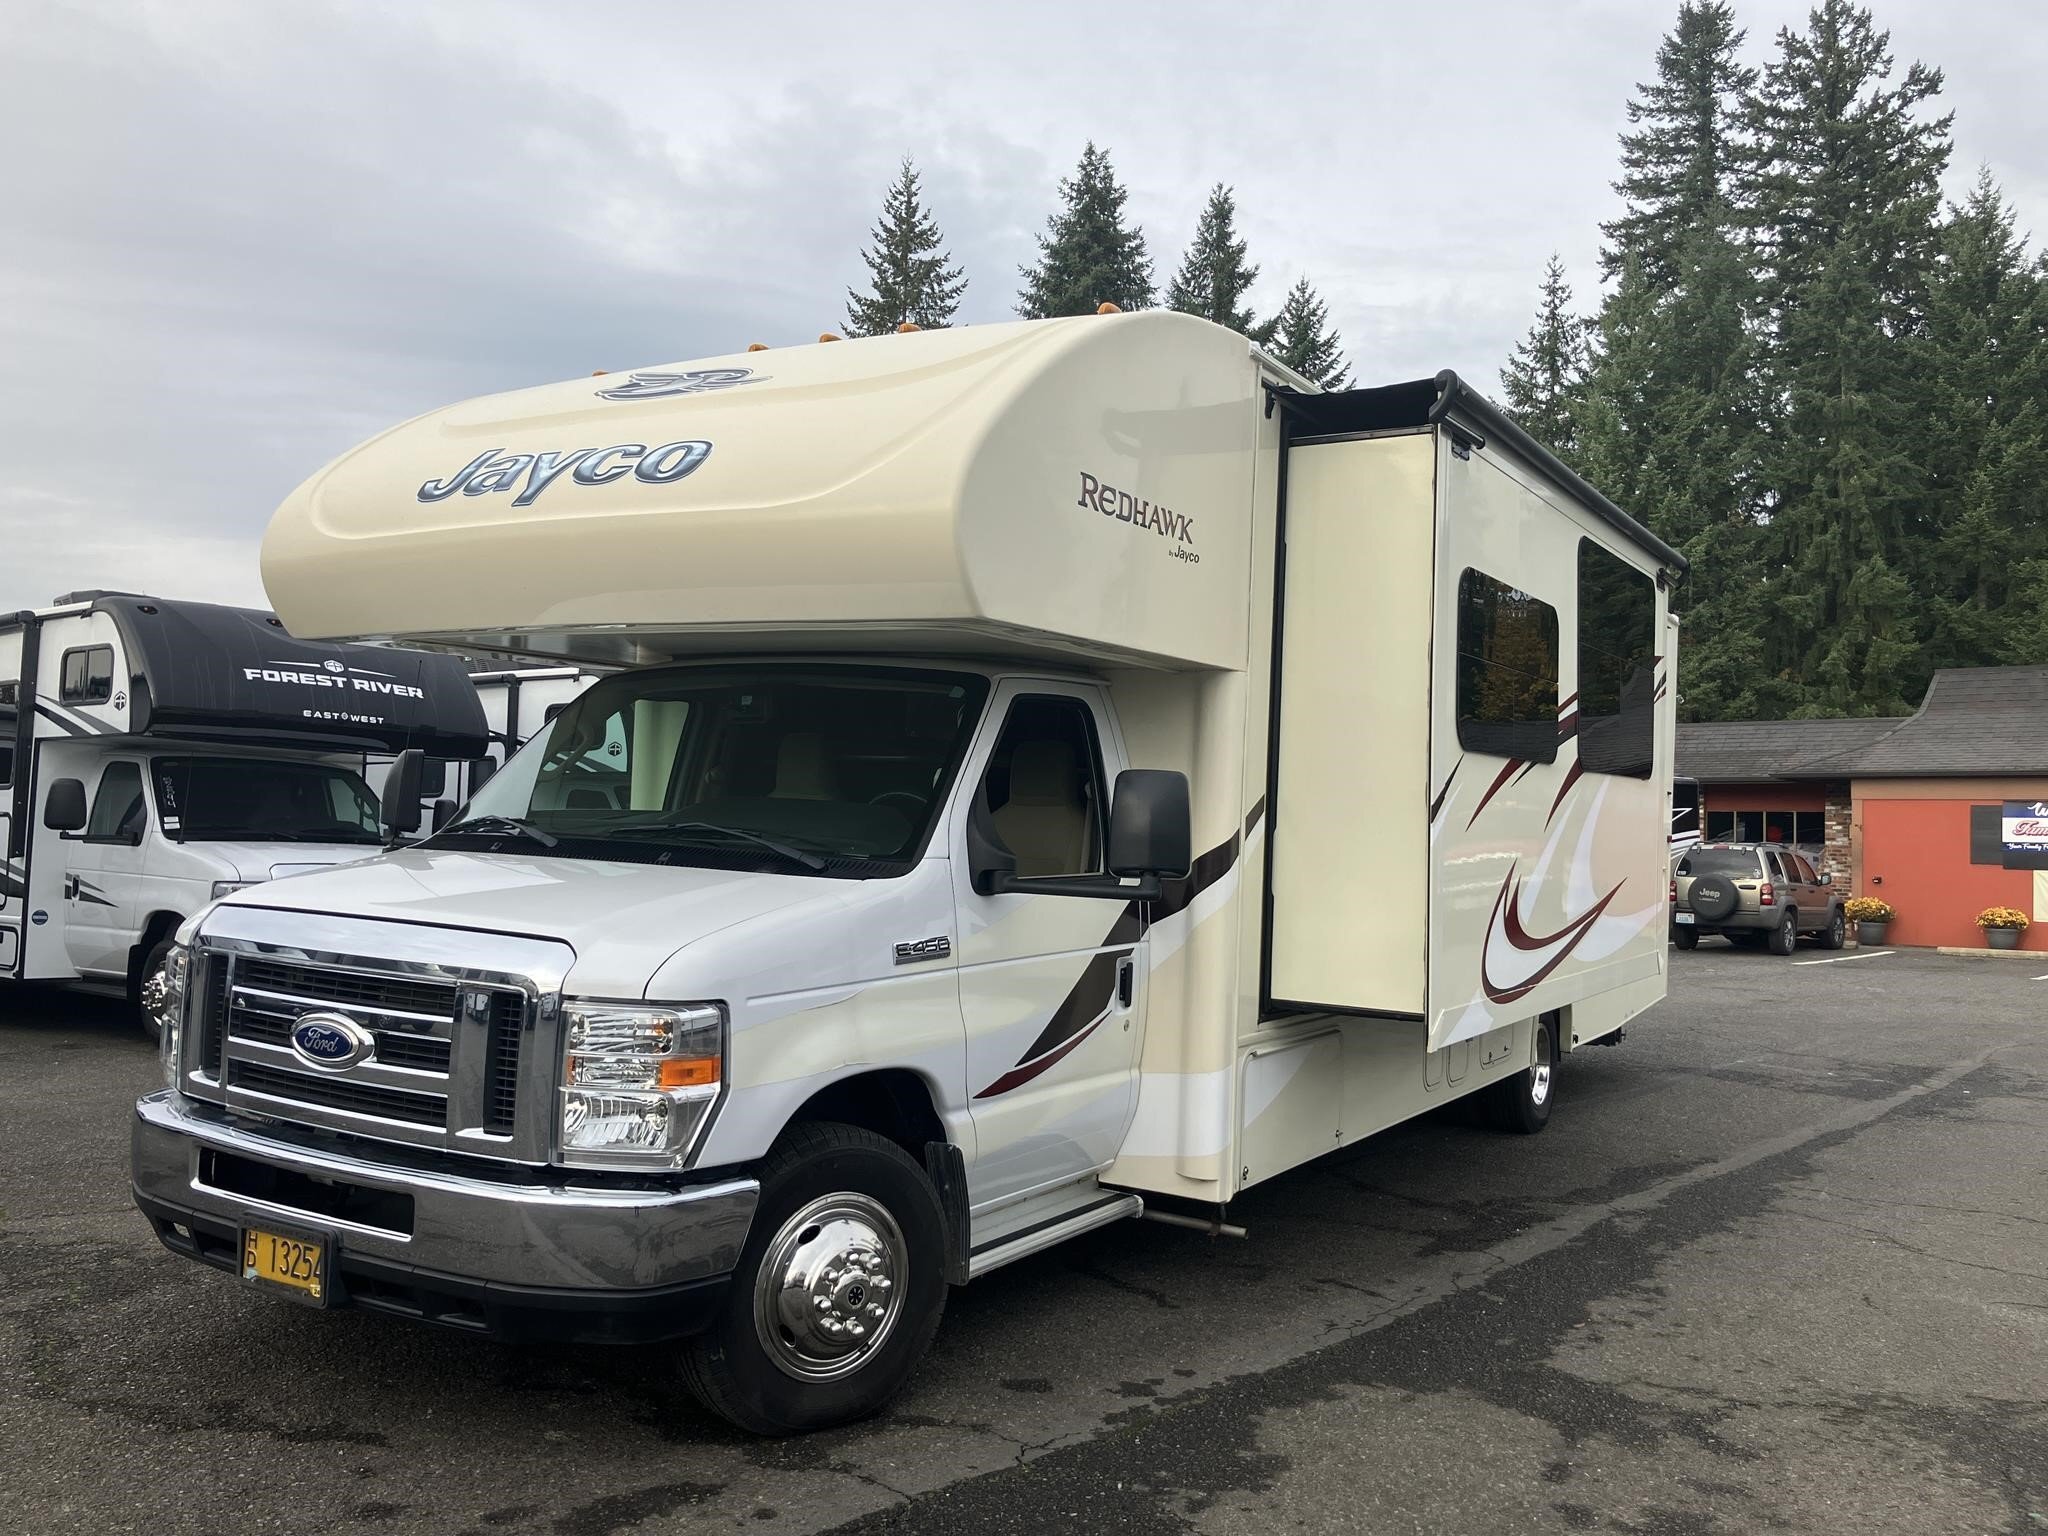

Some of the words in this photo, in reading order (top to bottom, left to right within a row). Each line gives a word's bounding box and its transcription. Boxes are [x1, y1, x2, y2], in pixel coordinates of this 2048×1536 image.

[417, 440, 713, 507] Jayco
[1077, 471, 1194, 545] REDHAWK
[1174, 545, 1200, 564] Jayco
[243, 668, 348, 688] FOREST
[351, 678, 425, 699] RIVER
[303, 709, 340, 720] EAST
[350, 714, 385, 725] WEST
[1699, 887, 1721, 898] Jeep
[304, 1027, 340, 1053] Ford
